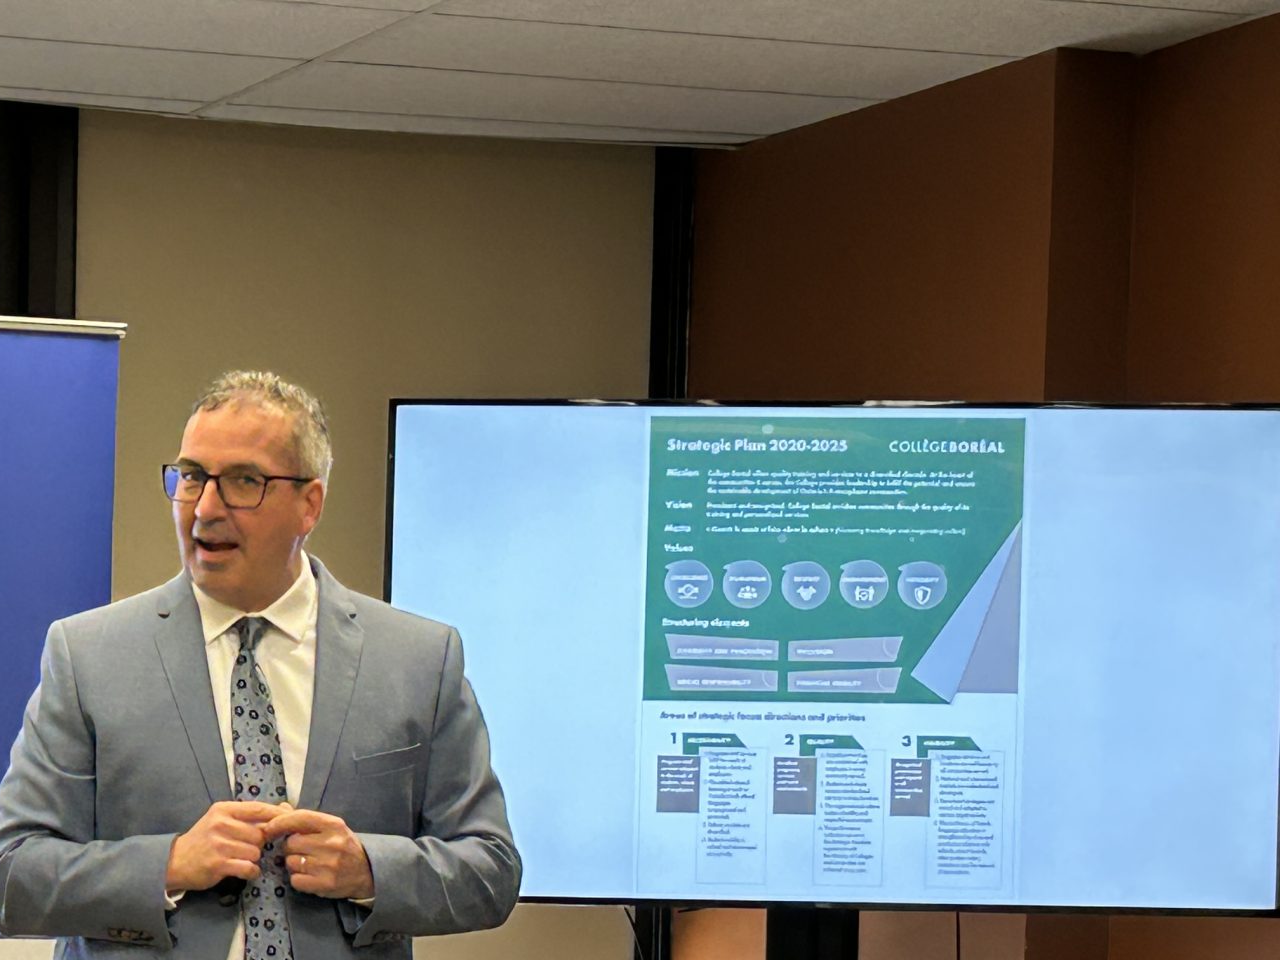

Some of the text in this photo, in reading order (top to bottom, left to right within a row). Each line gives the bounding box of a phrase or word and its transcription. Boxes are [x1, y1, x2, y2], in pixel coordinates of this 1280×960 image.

[667, 438, 848, 454] Strategic Plan 2020-2025
[784, 733, 795, 746] 2
[901, 735, 912, 747] 3
